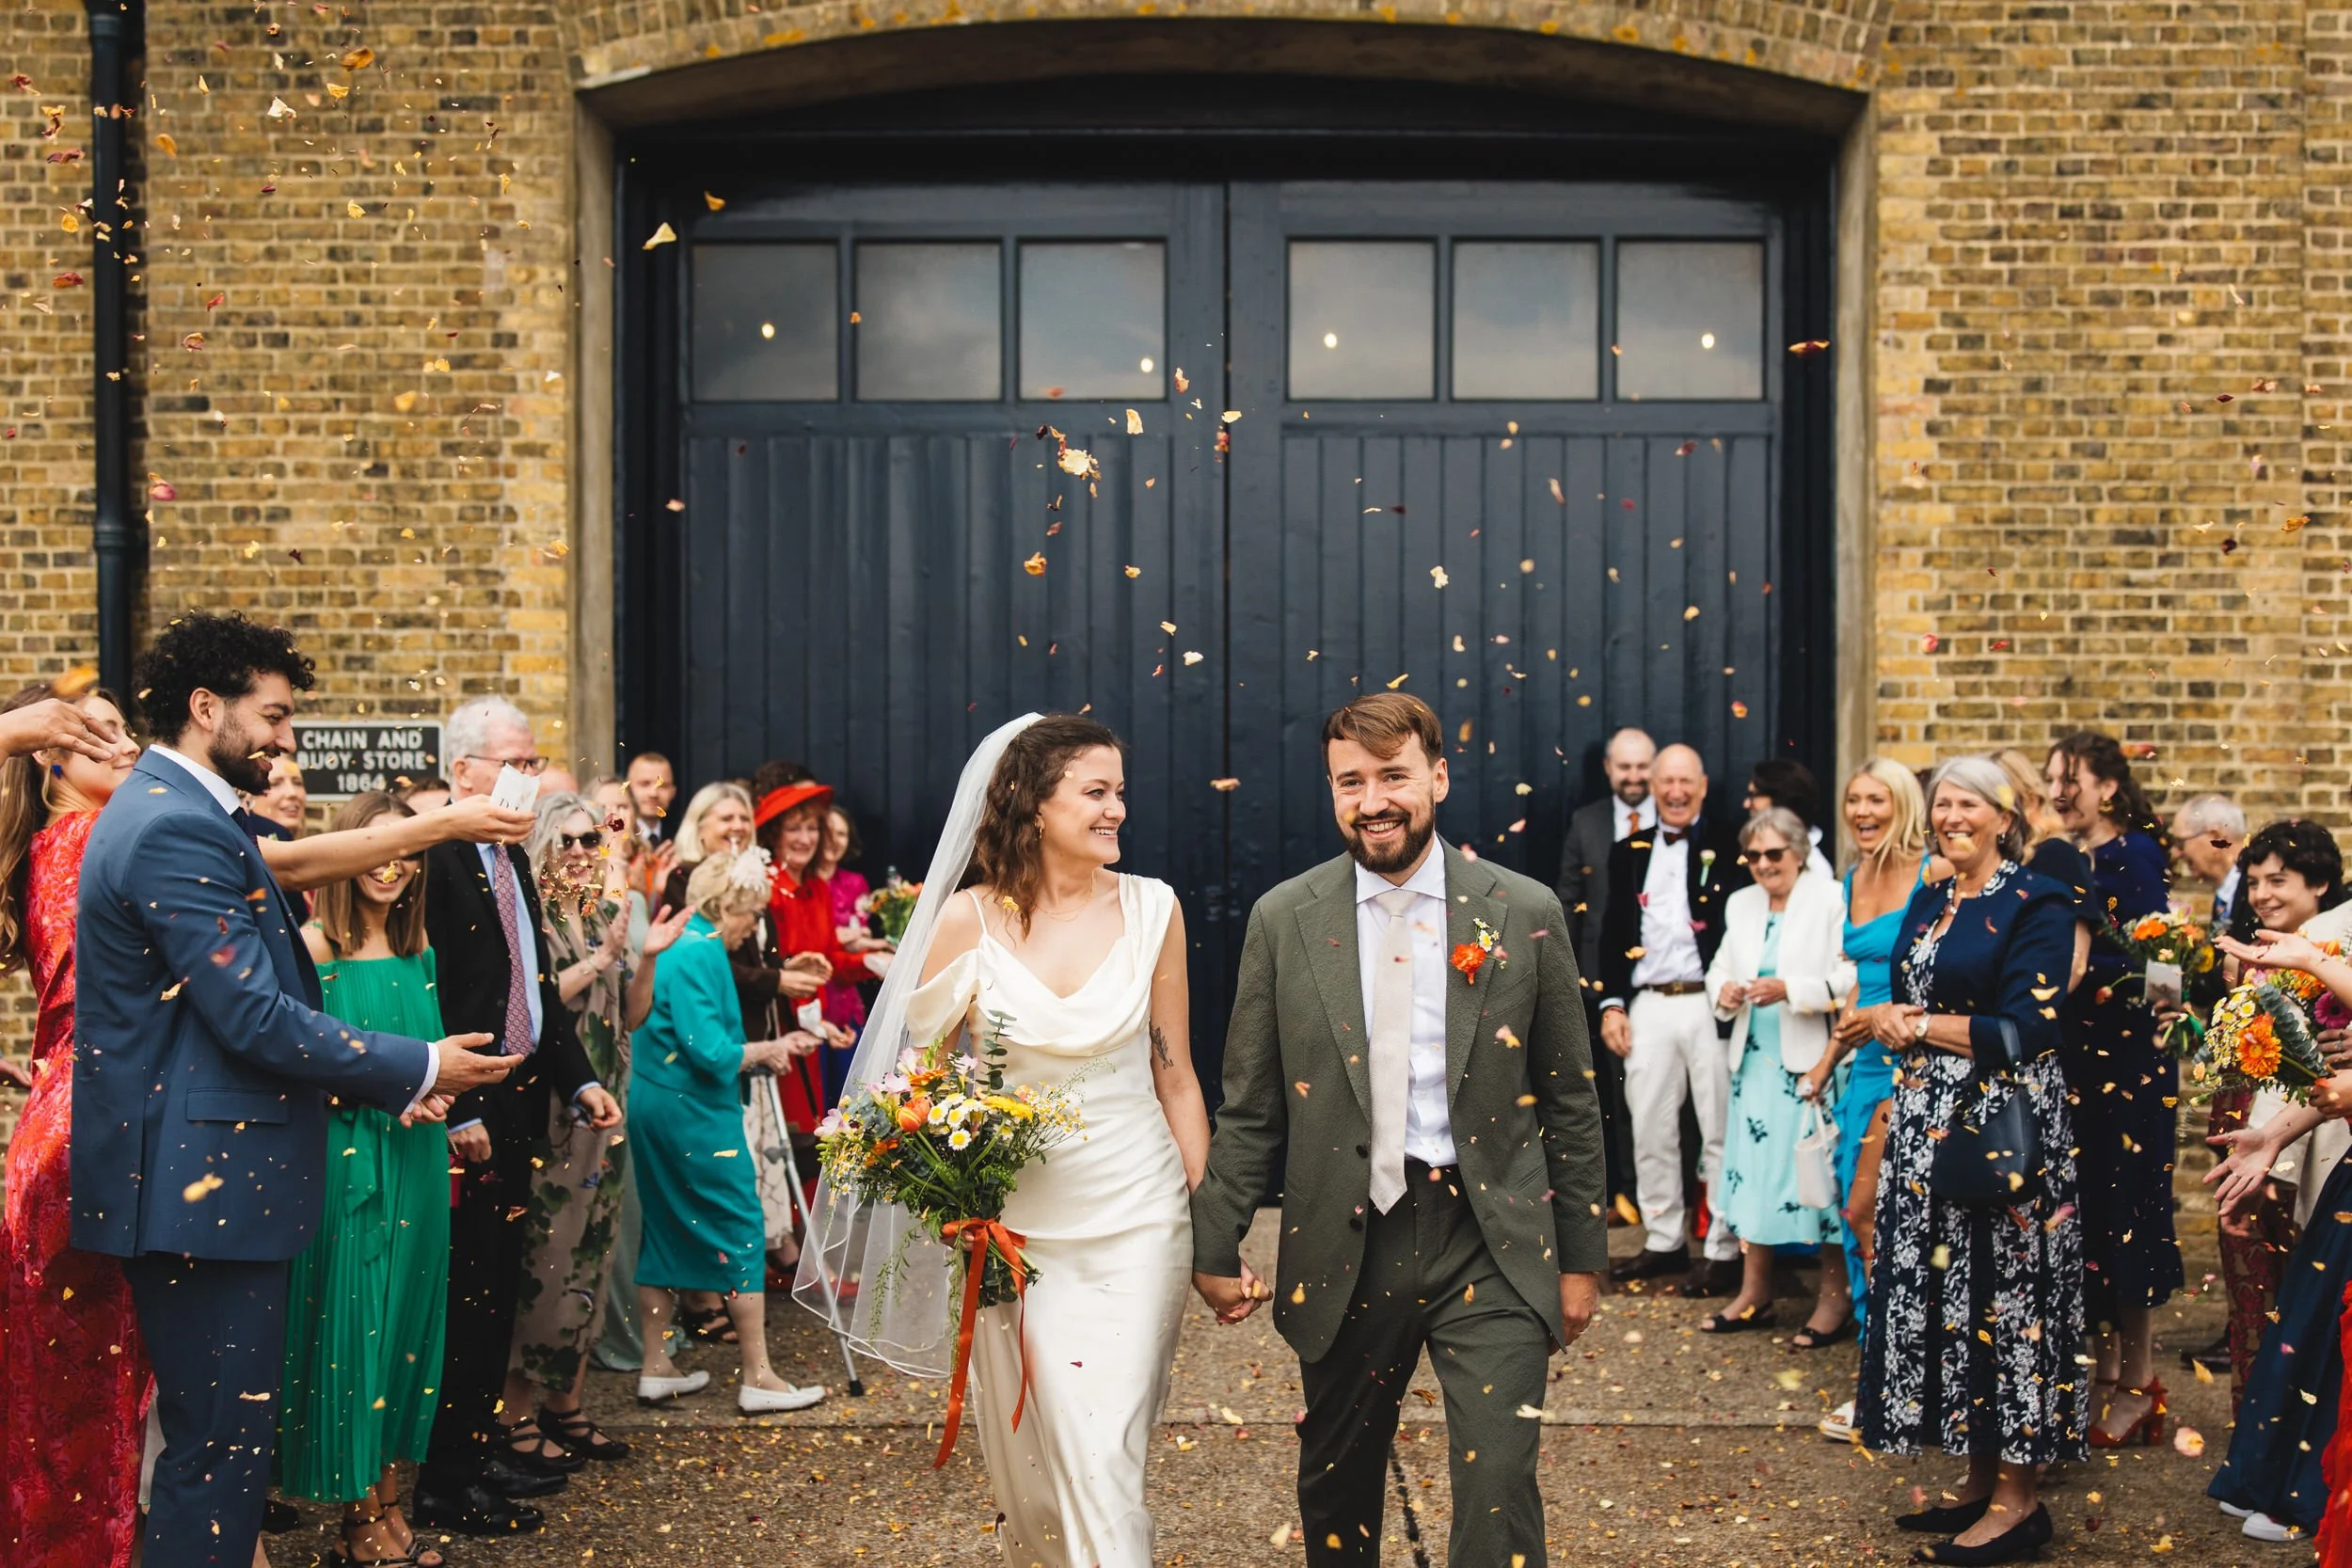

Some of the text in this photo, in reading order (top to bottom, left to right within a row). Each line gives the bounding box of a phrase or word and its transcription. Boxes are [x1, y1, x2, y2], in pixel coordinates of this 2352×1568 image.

[302, 730, 422, 749] CHAIN AND
[296, 751, 426, 769] BUOY STORE
[337, 773, 387, 792] 1864
